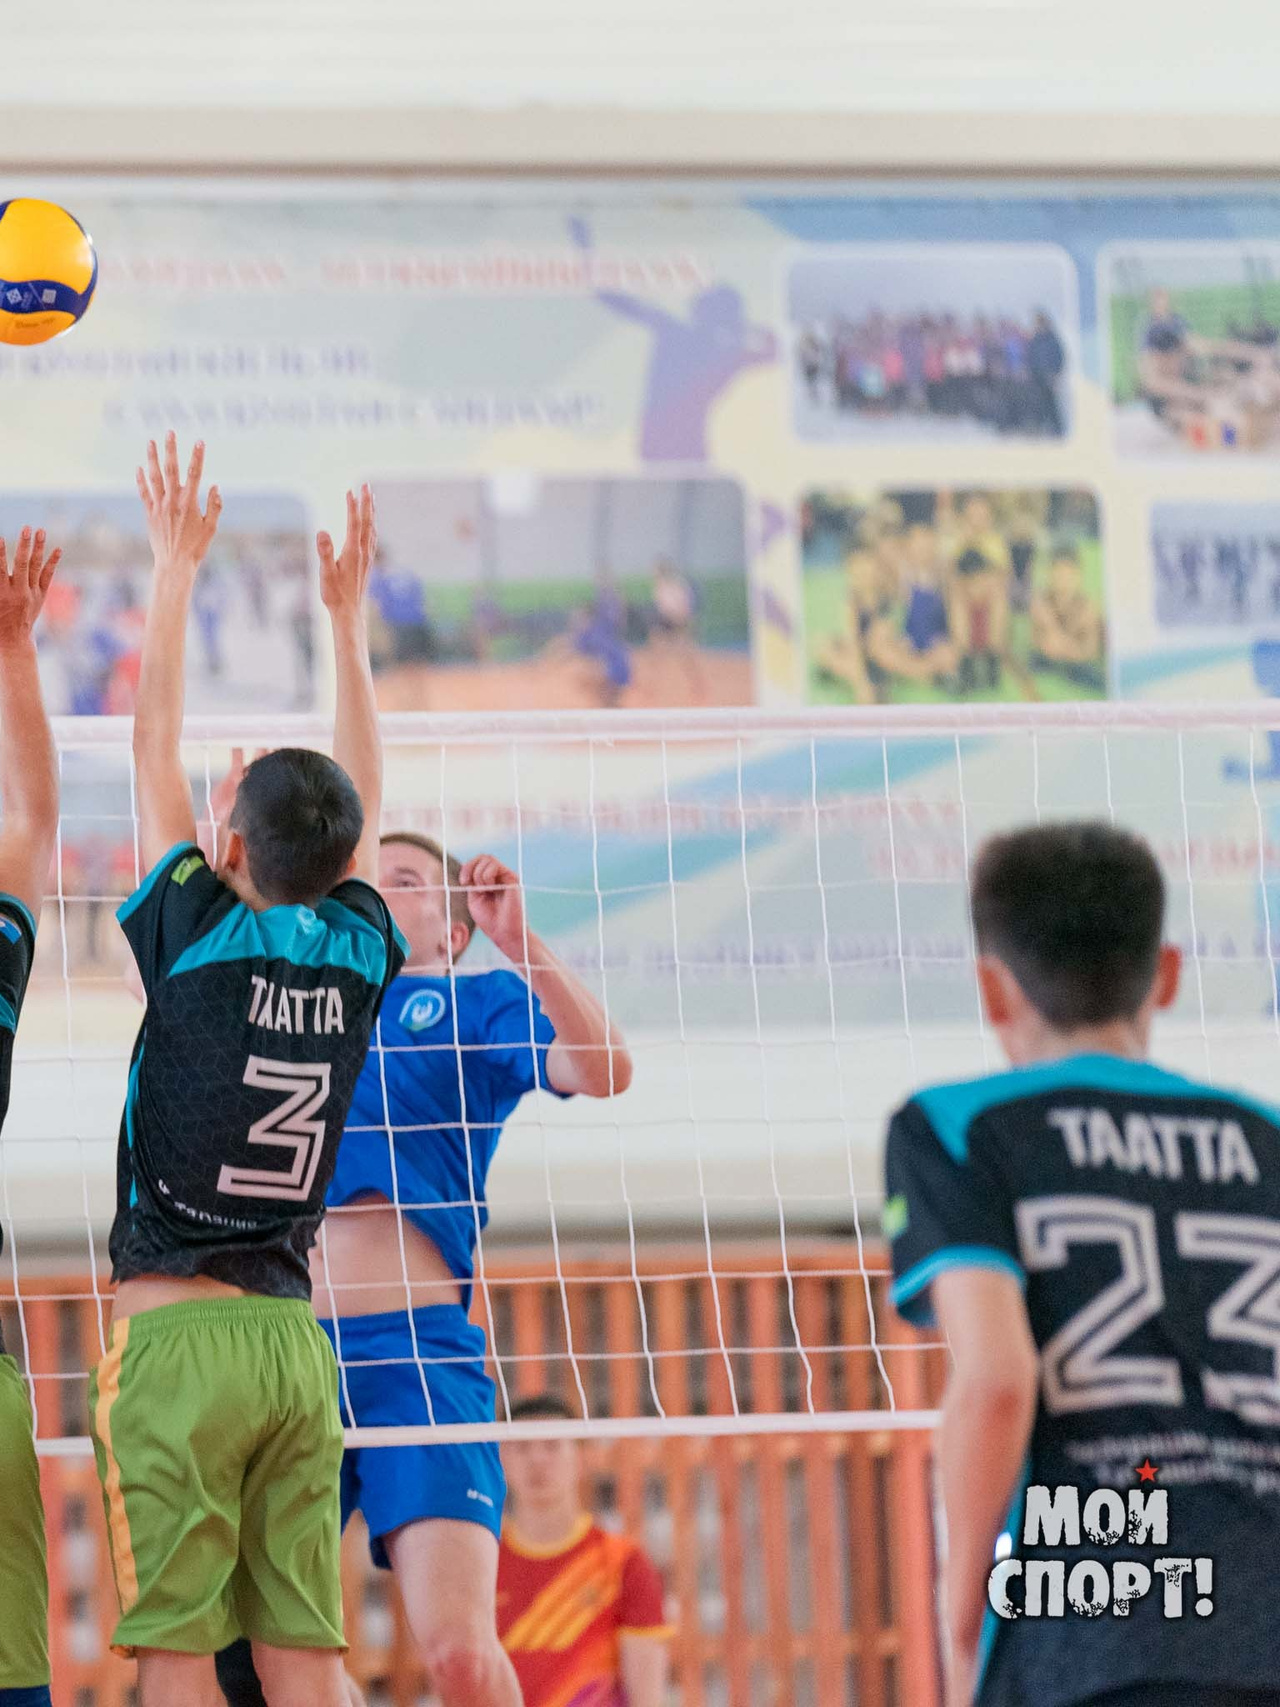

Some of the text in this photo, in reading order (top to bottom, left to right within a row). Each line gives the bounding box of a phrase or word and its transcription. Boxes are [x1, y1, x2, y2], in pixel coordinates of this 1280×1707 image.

[220, 1054, 332, 1202] 3
[1046, 1107, 1260, 1186] ТААТТА
[1014, 1195, 1280, 1426] 23
